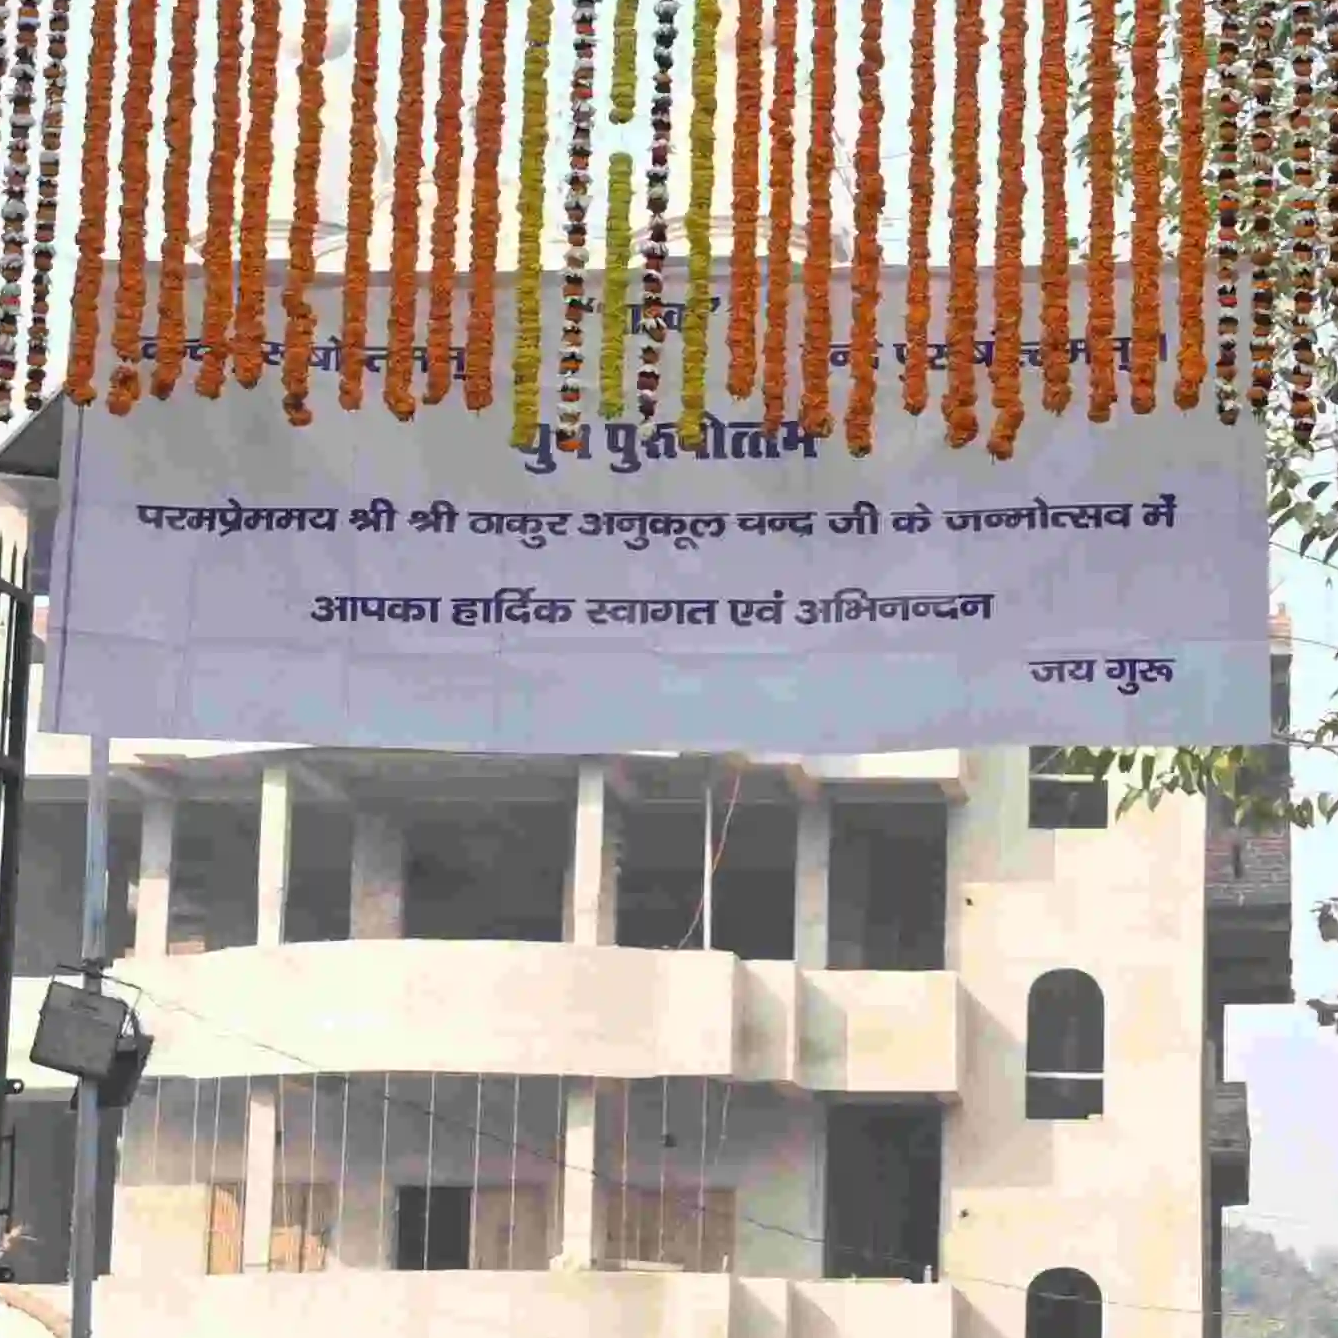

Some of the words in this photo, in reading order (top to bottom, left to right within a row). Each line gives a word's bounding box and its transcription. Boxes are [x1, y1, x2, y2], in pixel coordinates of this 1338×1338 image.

[137, 498, 338, 537] परमप्रेममय
[349, 497, 397, 532] श्री
[409, 500, 460, 533] श्री
[468, 512, 573, 550] ठाकुर
[577, 512, 730, 551] अनुकूल
[825, 500, 880, 535] जी
[890, 502, 933, 534] के
[944, 496, 1134, 532] जन्मोत्सव
[1142, 493, 1178, 528] में
[310, 595, 442, 623] आपका
[450, 587, 576, 627] हार्दिक
[586, 598, 720, 625] स्वागत
[727, 589, 785, 627] एवं
[795, 587, 995, 625] अभिनन्दन
[1028, 658, 1097, 683] जय
[1105, 657, 1176, 696] गुरू
